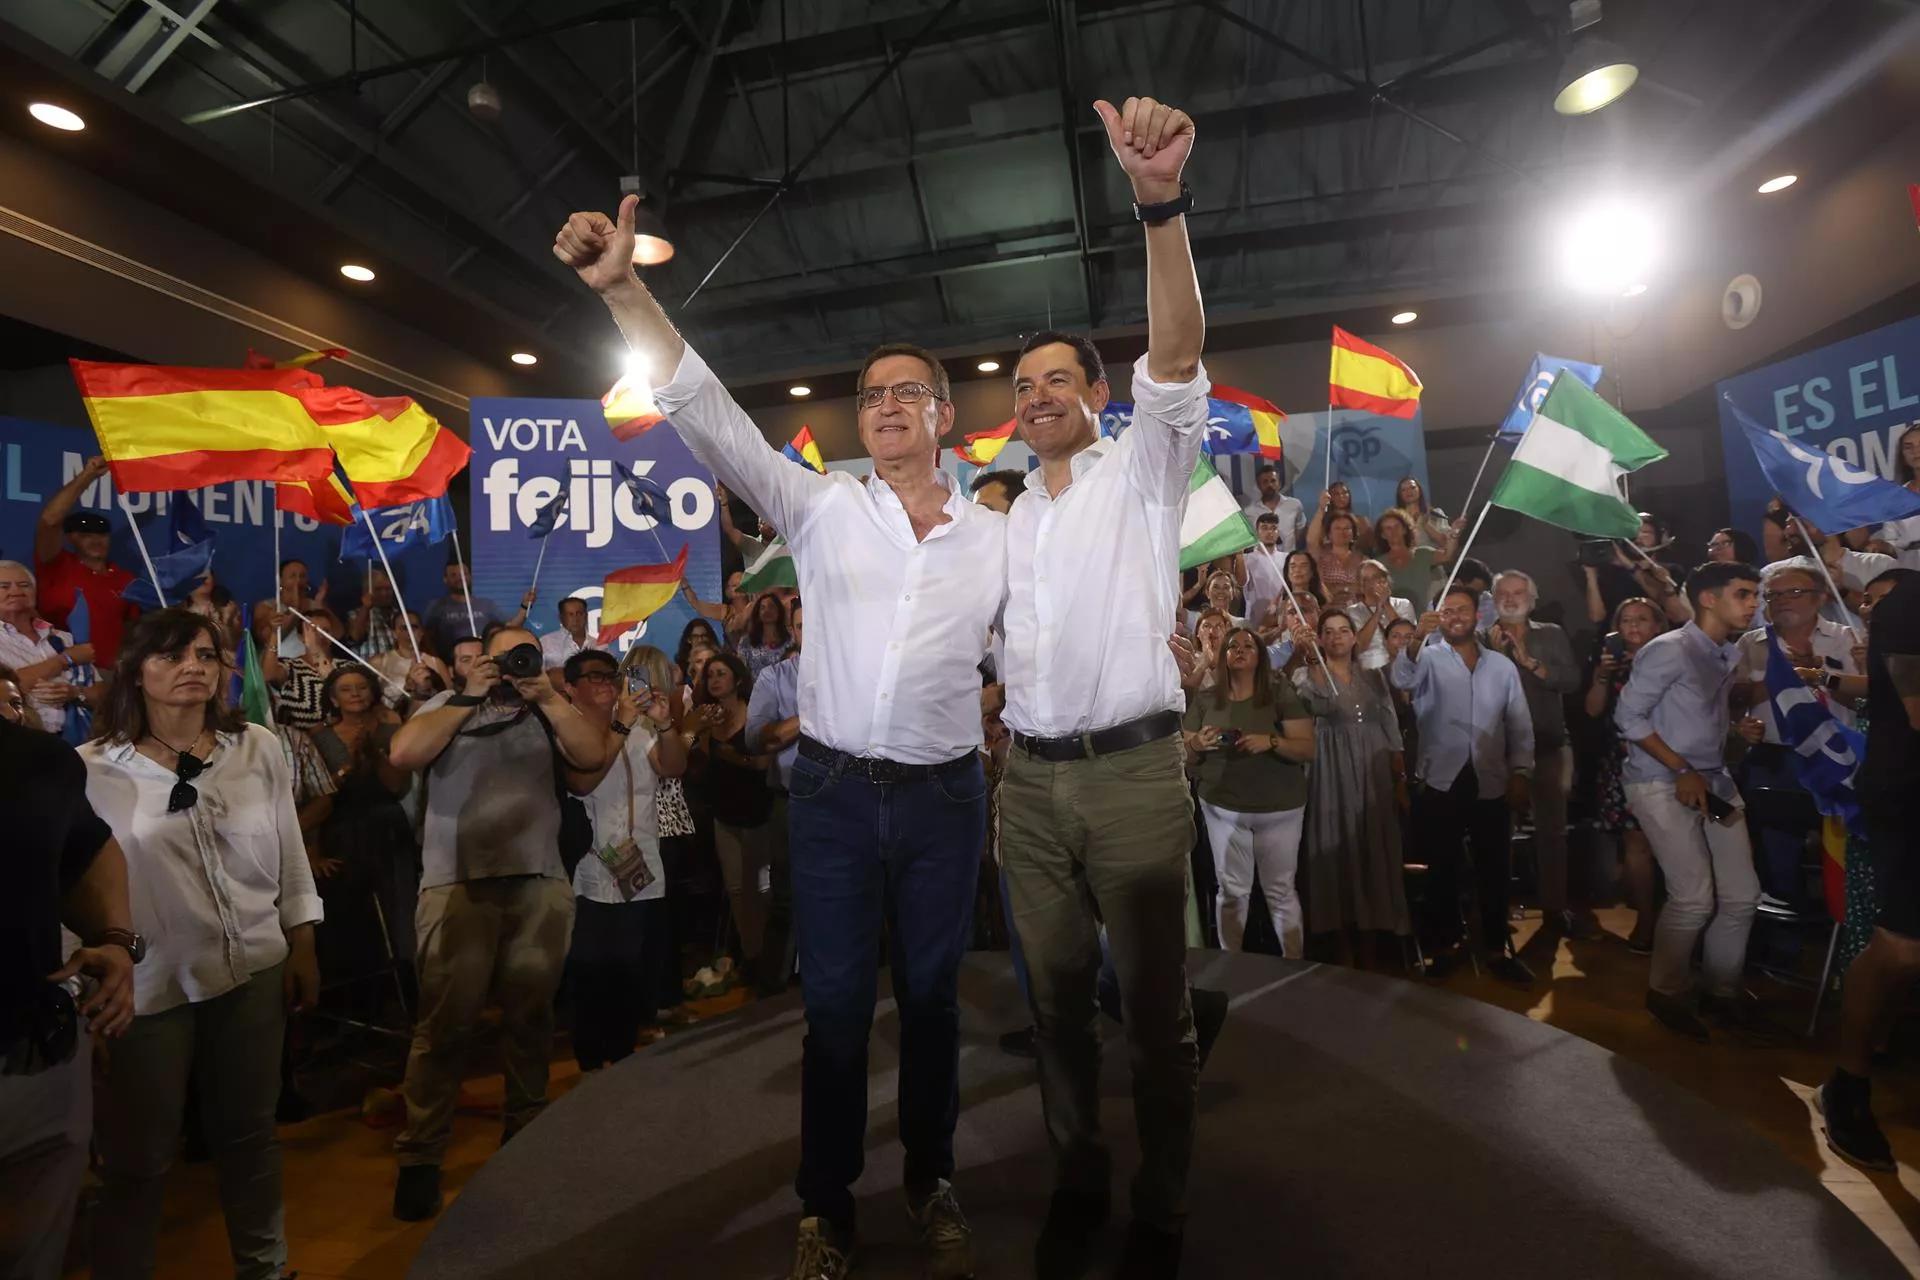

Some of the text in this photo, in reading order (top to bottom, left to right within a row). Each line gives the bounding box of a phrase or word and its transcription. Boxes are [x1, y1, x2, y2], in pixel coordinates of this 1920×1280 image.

[483, 418, 587, 452] VOTA
[1773, 354, 1919, 437] ES EL
[483, 457, 715, 548] feijóo
